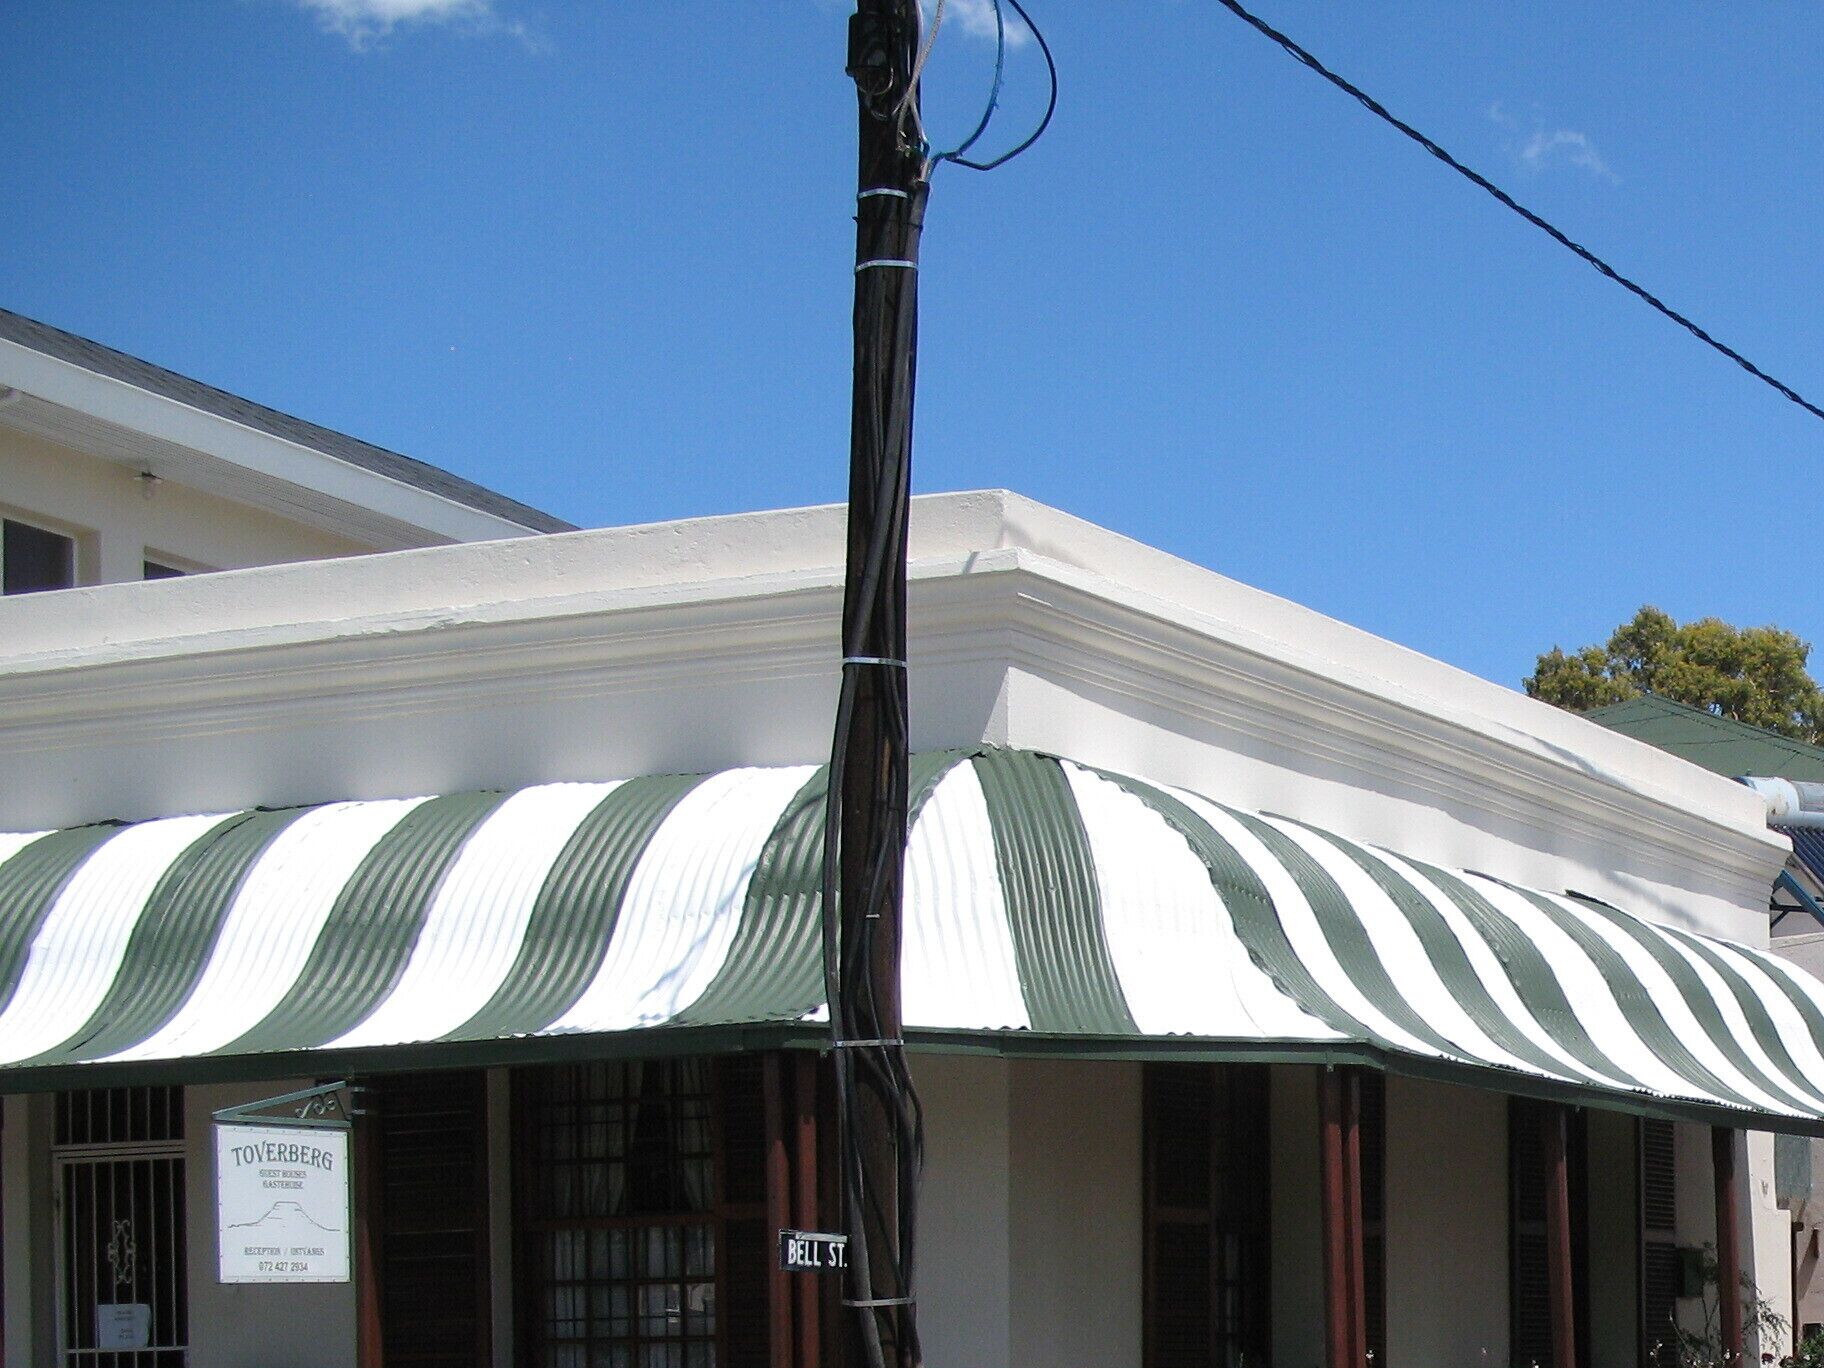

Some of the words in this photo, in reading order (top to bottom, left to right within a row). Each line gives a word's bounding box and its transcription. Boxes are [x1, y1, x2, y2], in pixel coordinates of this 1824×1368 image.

[231, 1140, 333, 1171] TOVERBERG
[274, 1262, 288, 1271] 427
[787, 1239, 822, 1267] BELL
[828, 1242, 848, 1268] ST.
